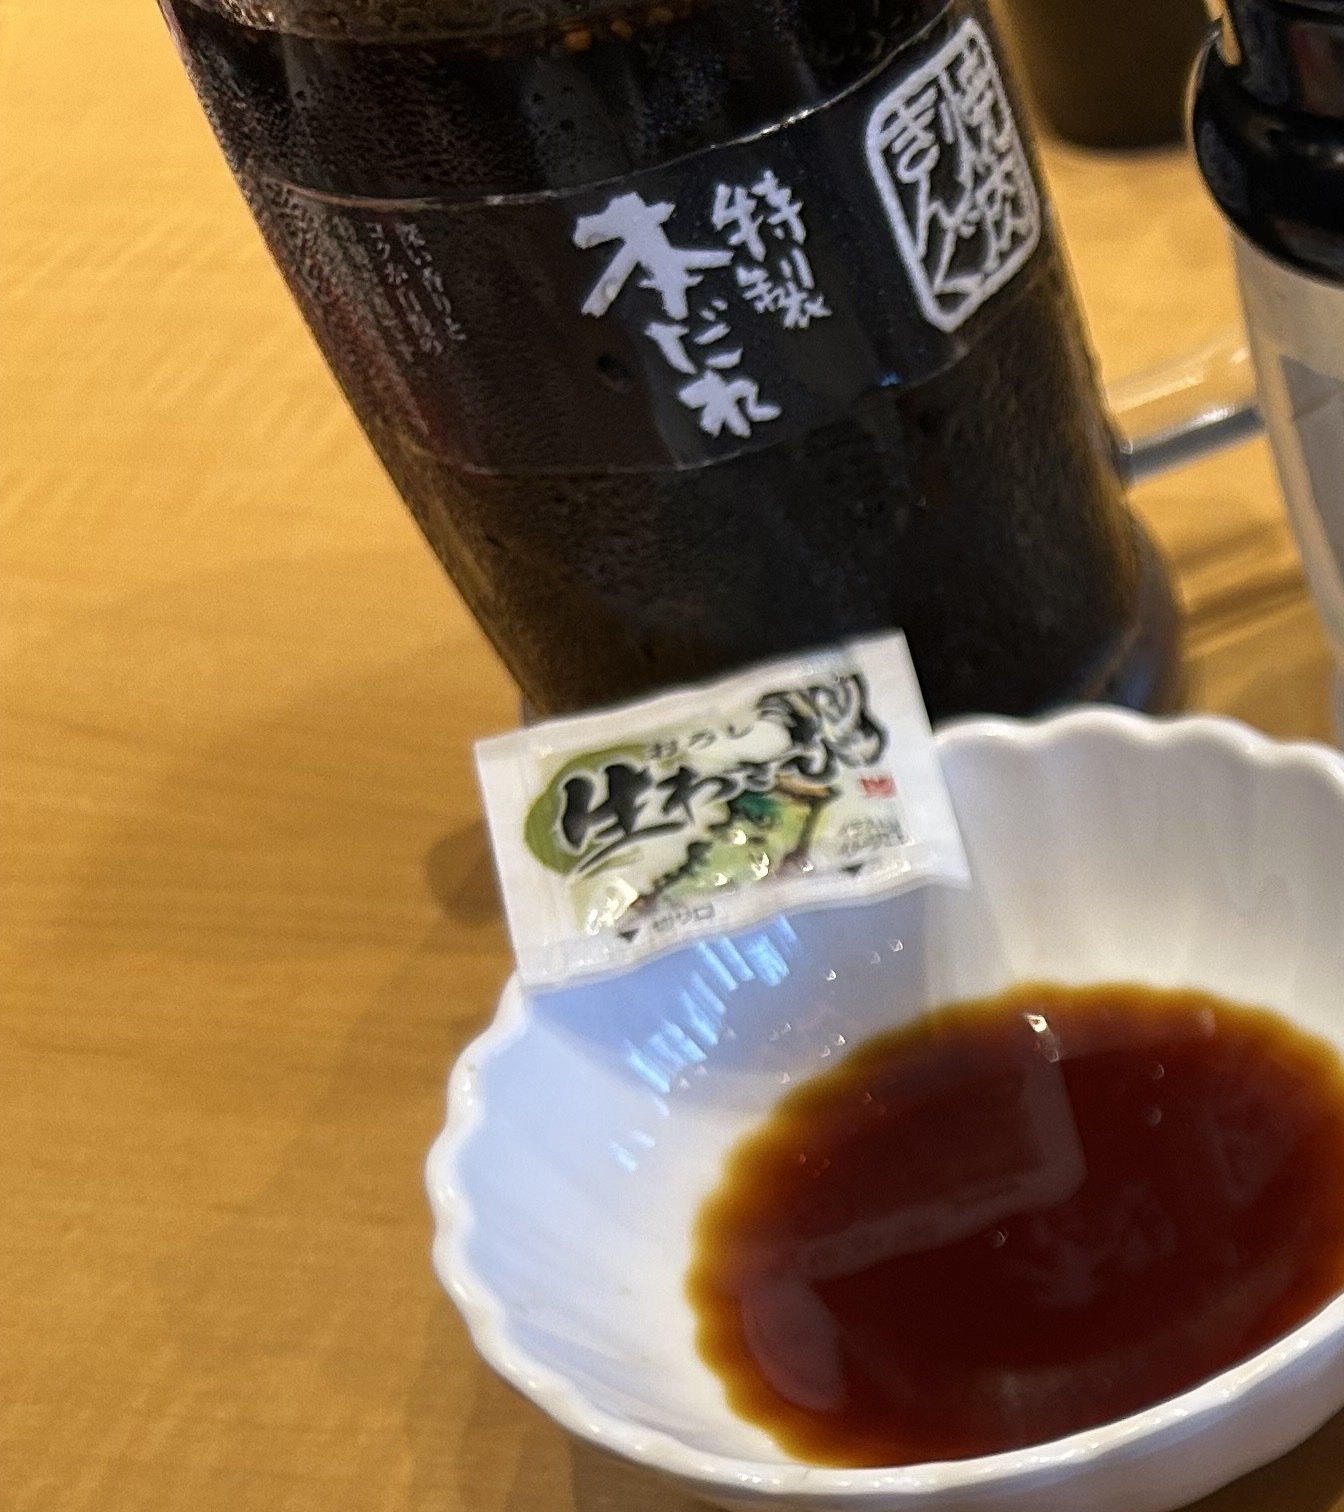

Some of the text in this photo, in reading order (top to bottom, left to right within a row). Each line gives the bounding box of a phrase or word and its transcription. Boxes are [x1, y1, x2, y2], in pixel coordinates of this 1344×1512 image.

[573, 192, 781, 438] 本だれ
[712, 170, 831, 330] 特製
